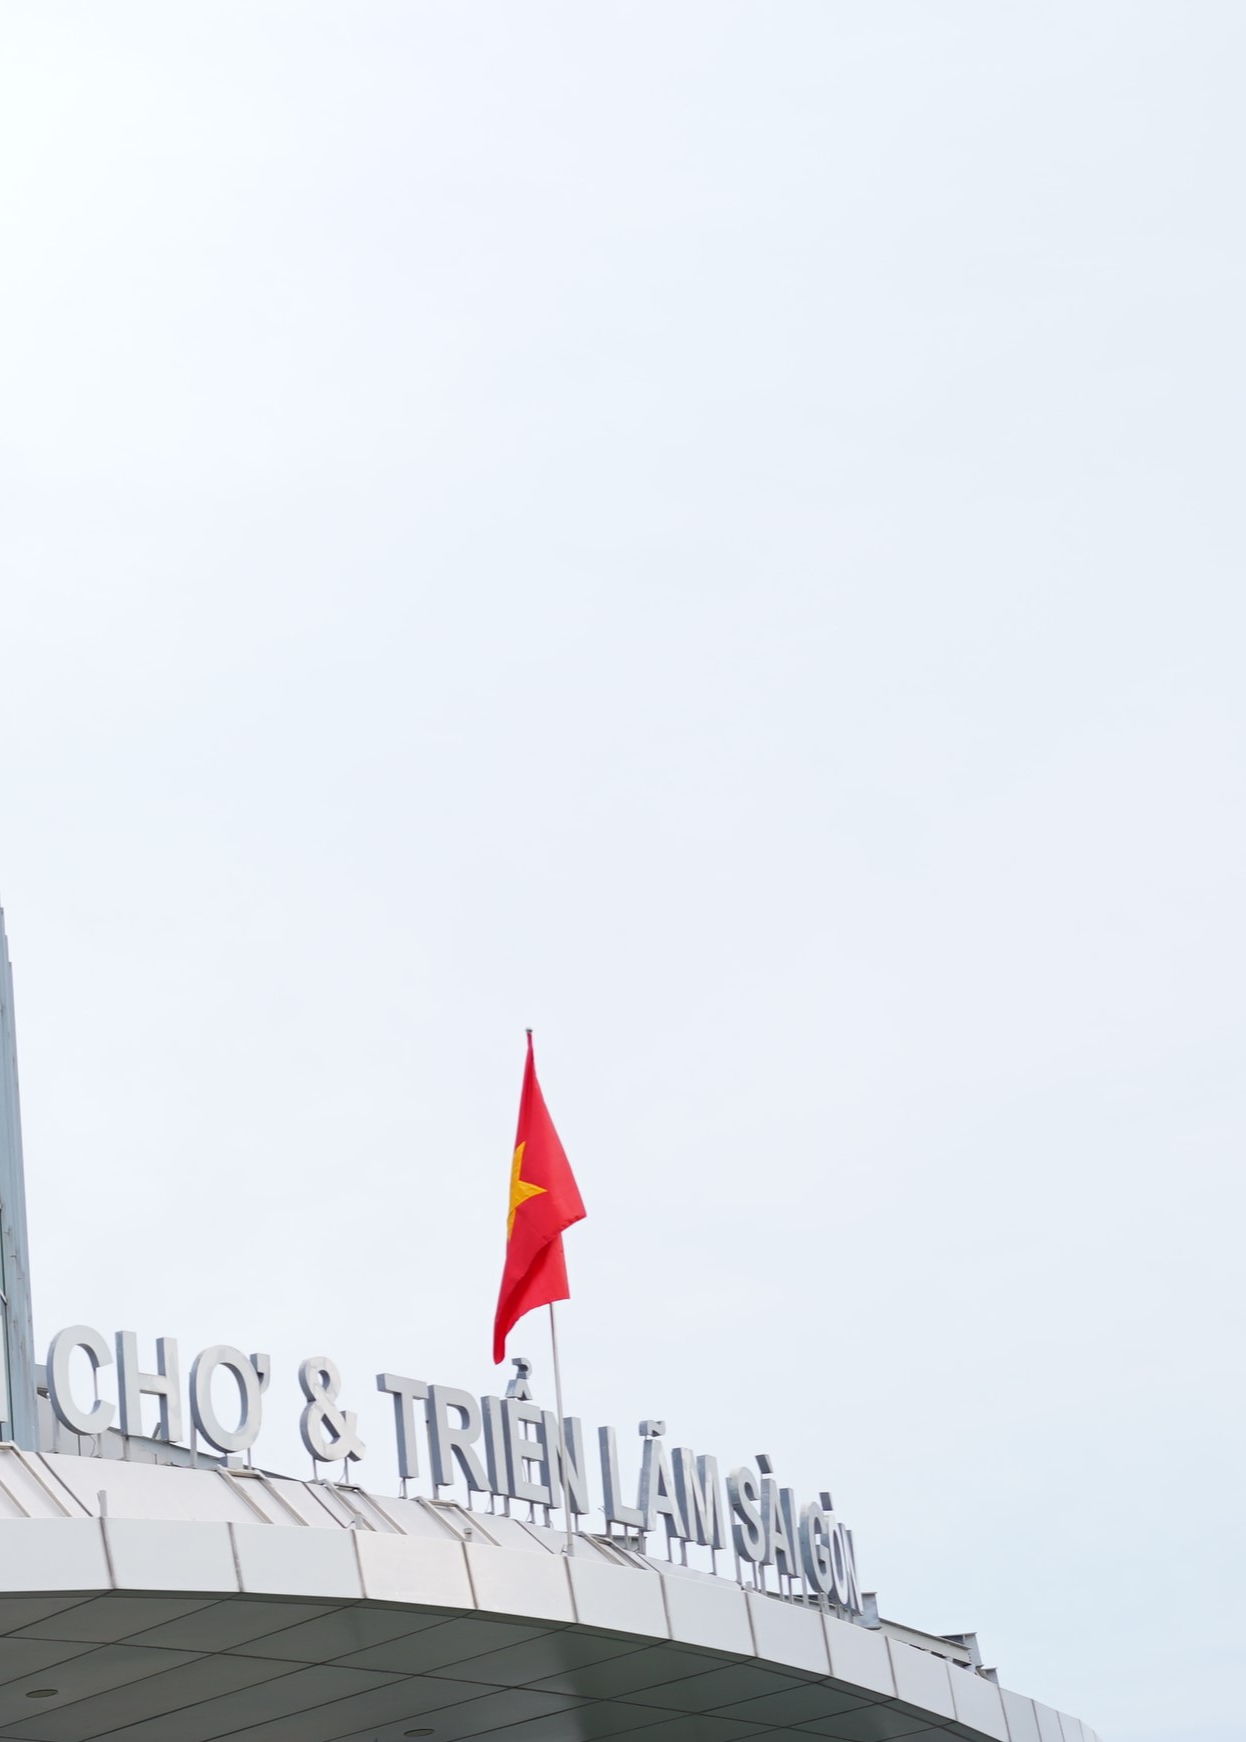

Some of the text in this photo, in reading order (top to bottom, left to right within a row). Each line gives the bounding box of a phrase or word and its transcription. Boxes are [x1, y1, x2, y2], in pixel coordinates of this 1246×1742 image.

[299, 1356, 366, 1462] &
[376, 1357, 589, 1515] TRIỂN
[598, 1419, 726, 1550] LÃM
[728, 1454, 802, 1579] SÀI
